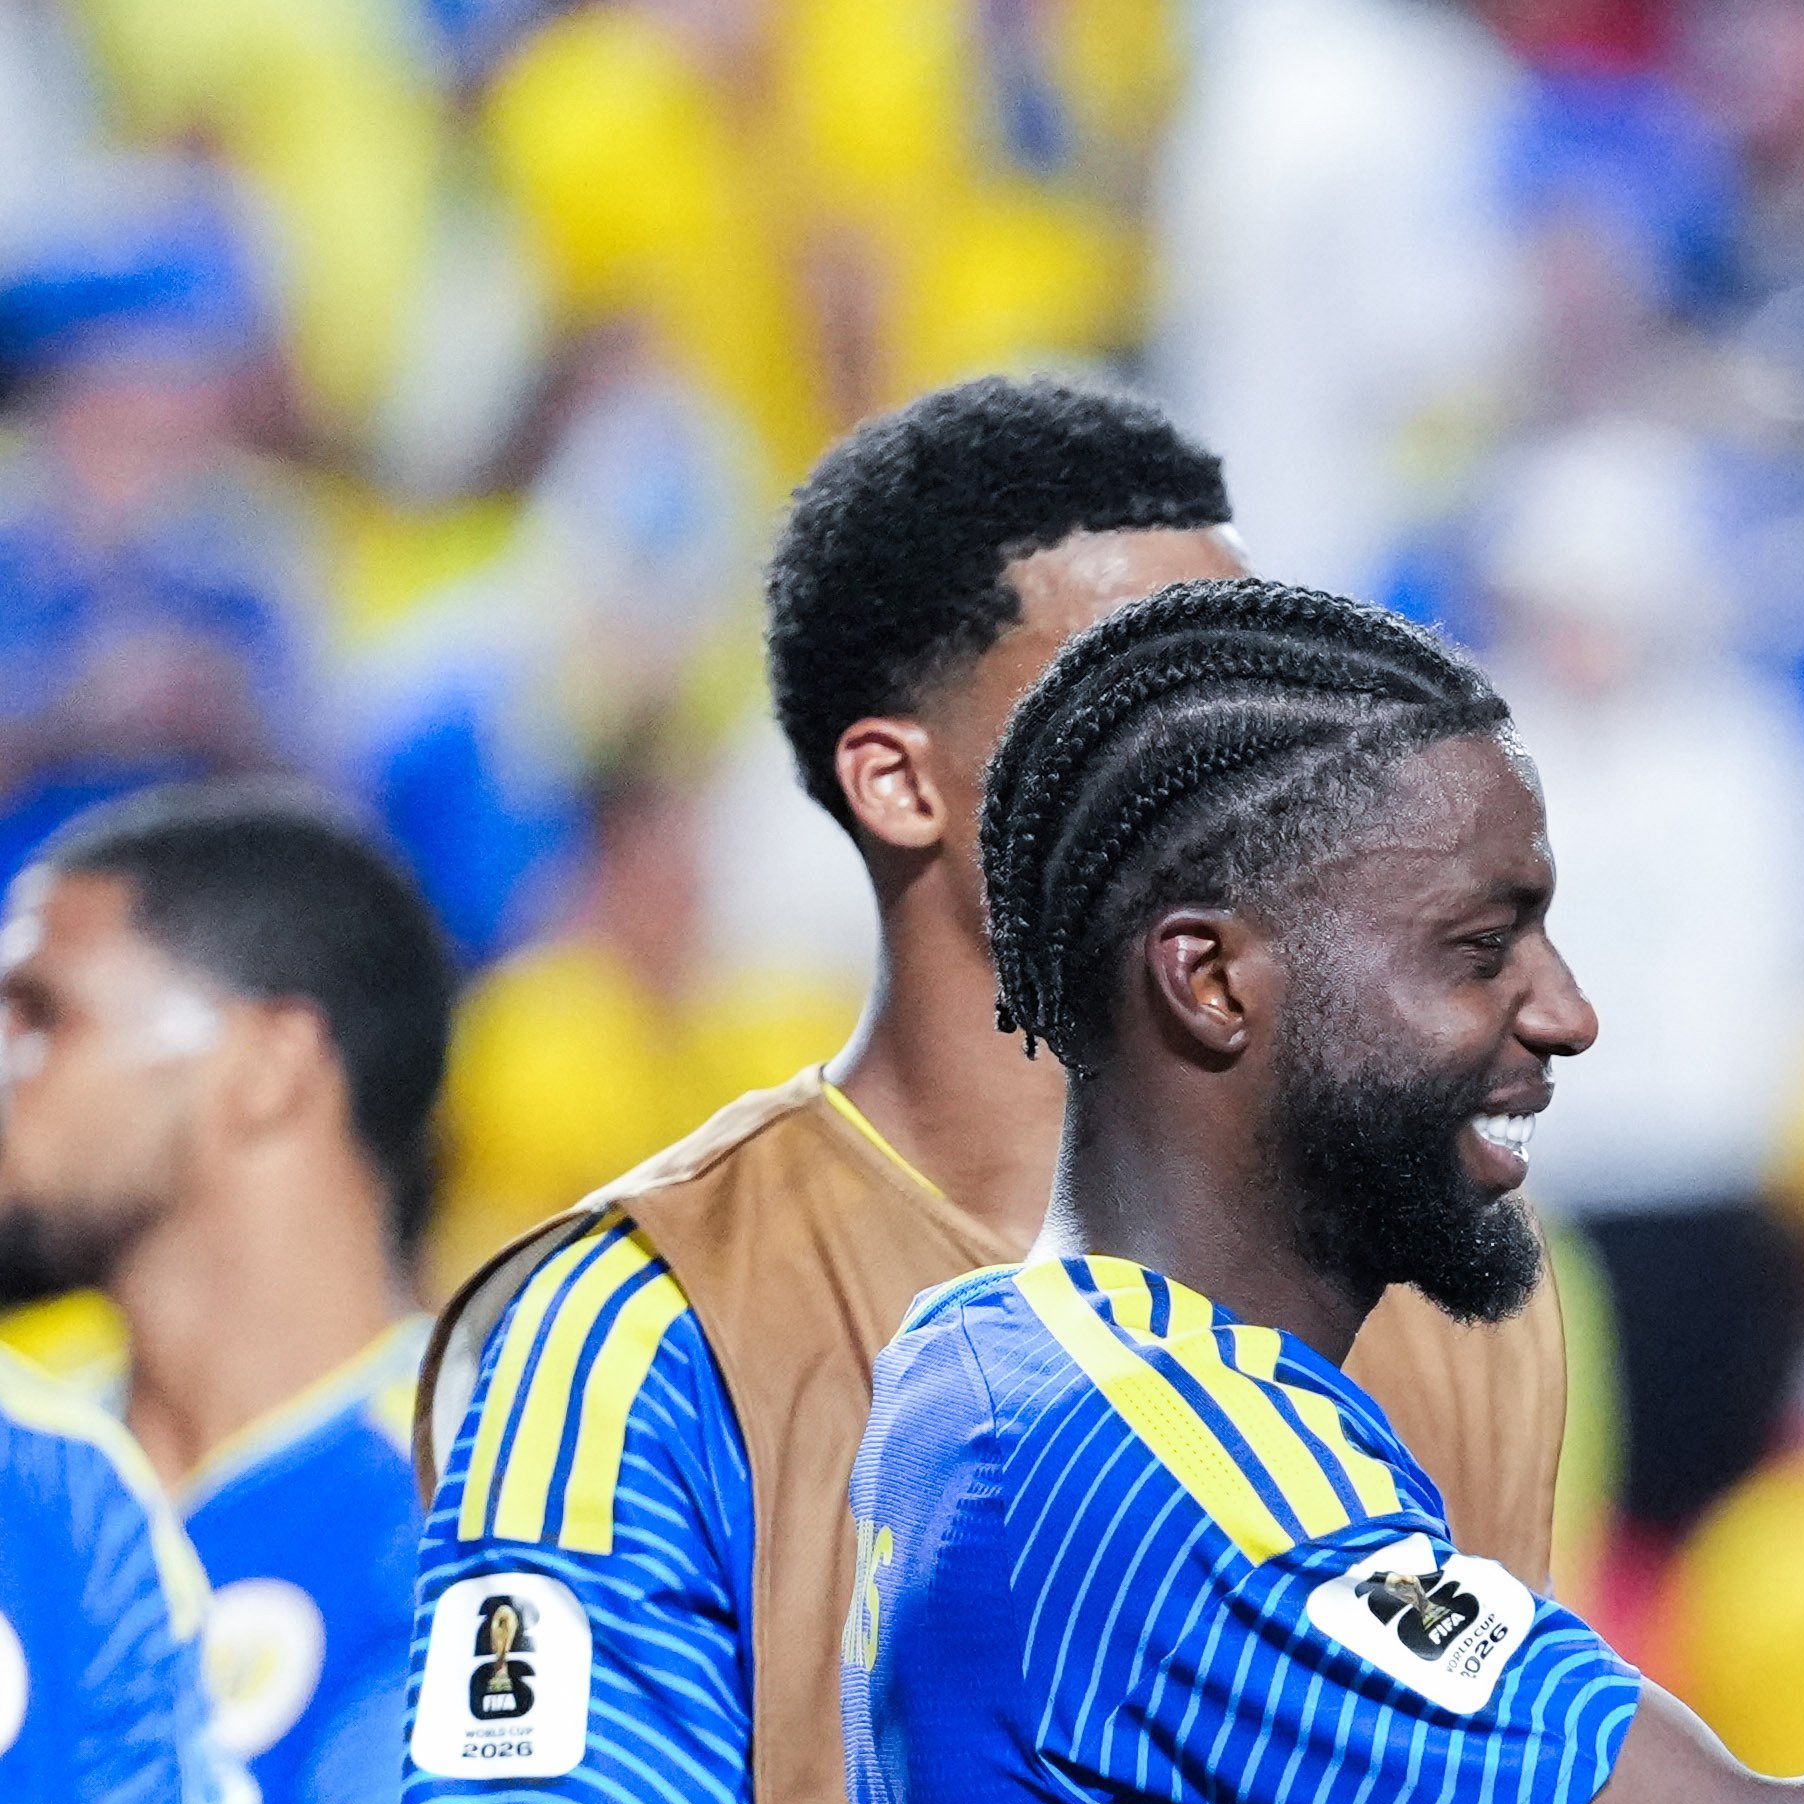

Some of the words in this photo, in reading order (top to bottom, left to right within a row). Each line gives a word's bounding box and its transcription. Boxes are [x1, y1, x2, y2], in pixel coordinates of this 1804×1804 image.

[1428, 1612, 1466, 1645] FIFA
[1446, 1637, 1474, 1673] WORLD
[1473, 1613, 1496, 1638] CUP
[1460, 1622, 1509, 1679] 2026
[461, 1741, 534, 1759] 2026
